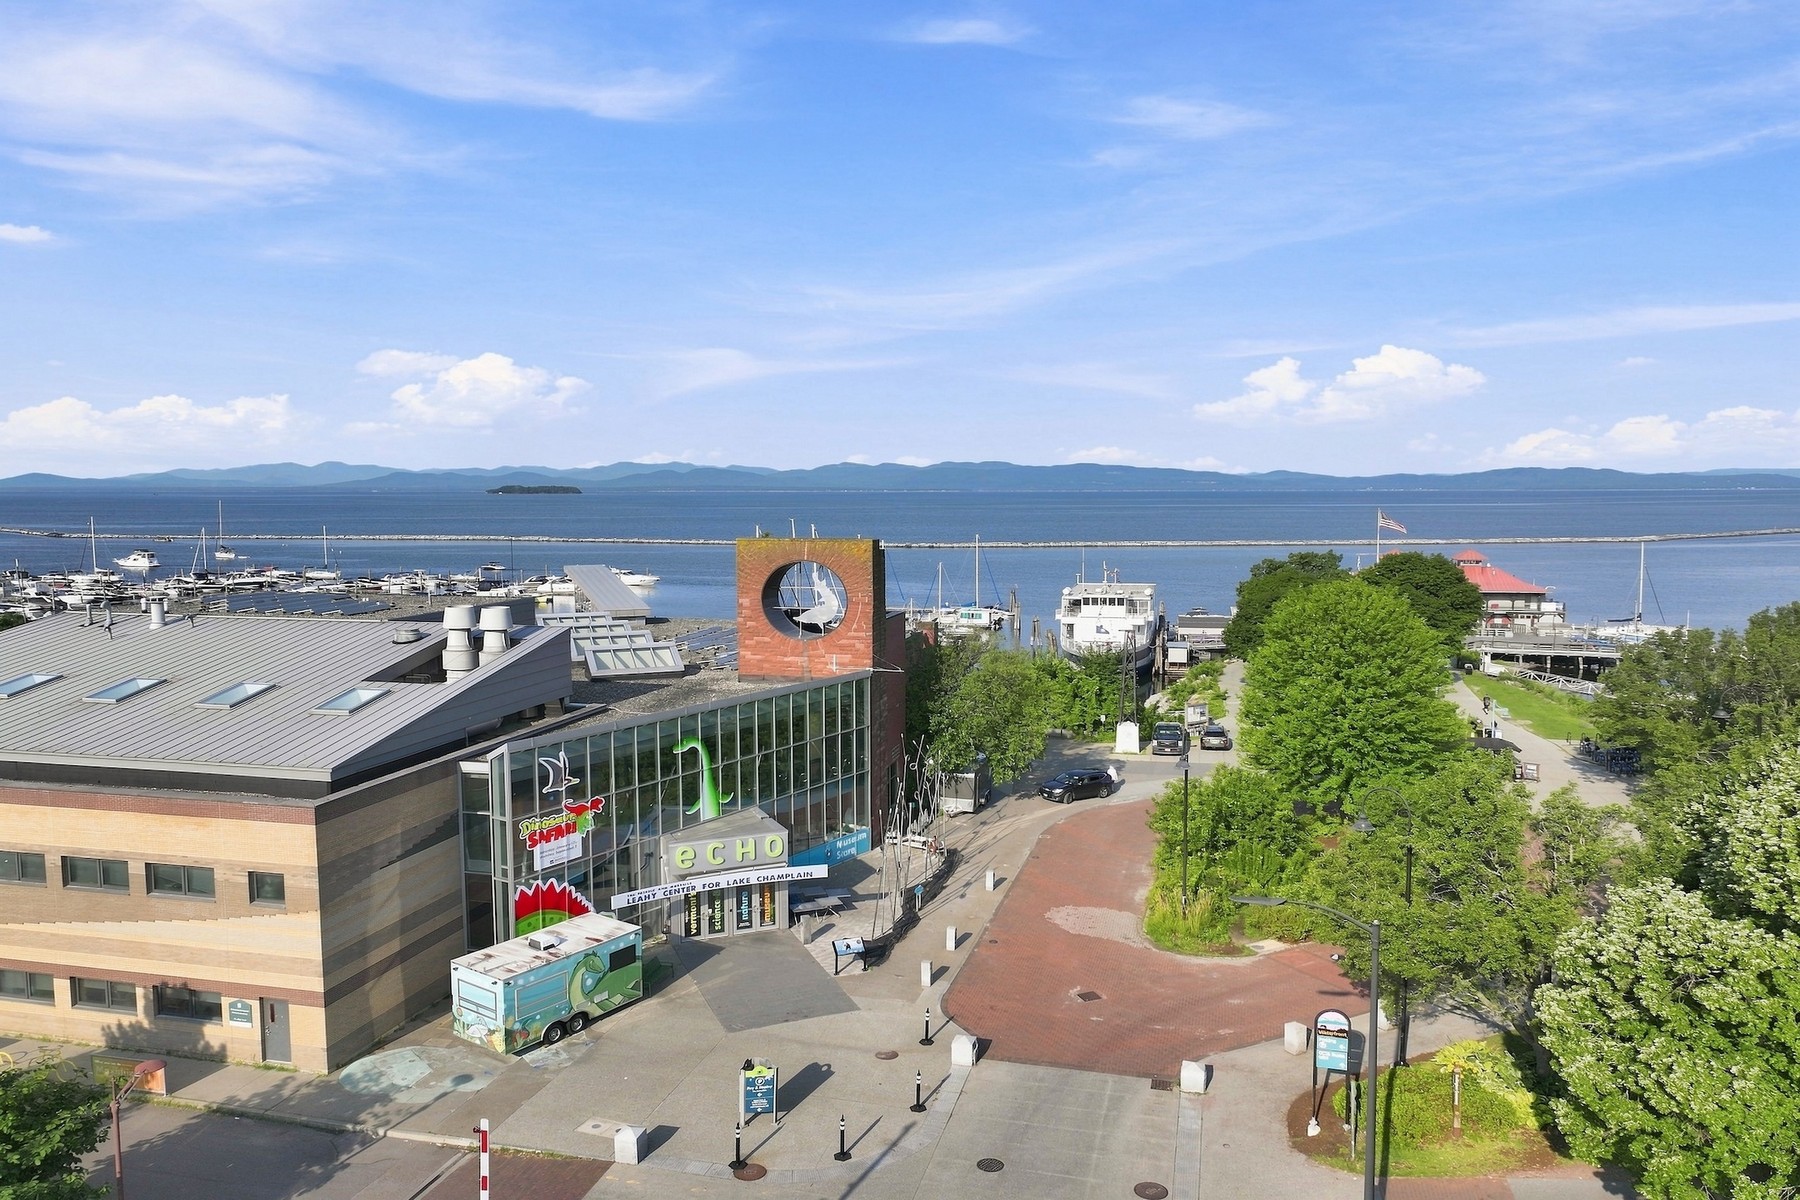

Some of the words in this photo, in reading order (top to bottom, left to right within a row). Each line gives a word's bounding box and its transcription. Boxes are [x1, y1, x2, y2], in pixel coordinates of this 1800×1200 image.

[527, 822, 577, 849] SAFARI
[627, 892, 657, 904] LEAHY
[663, 885, 696, 896] CENTER
[702, 881, 721, 889] FOR
[726, 877, 751, 886] LAKE
[756, 871, 813, 883] CHAMPLAIN
[712, 899, 721, 930] science
[741, 891, 749, 920] nature
